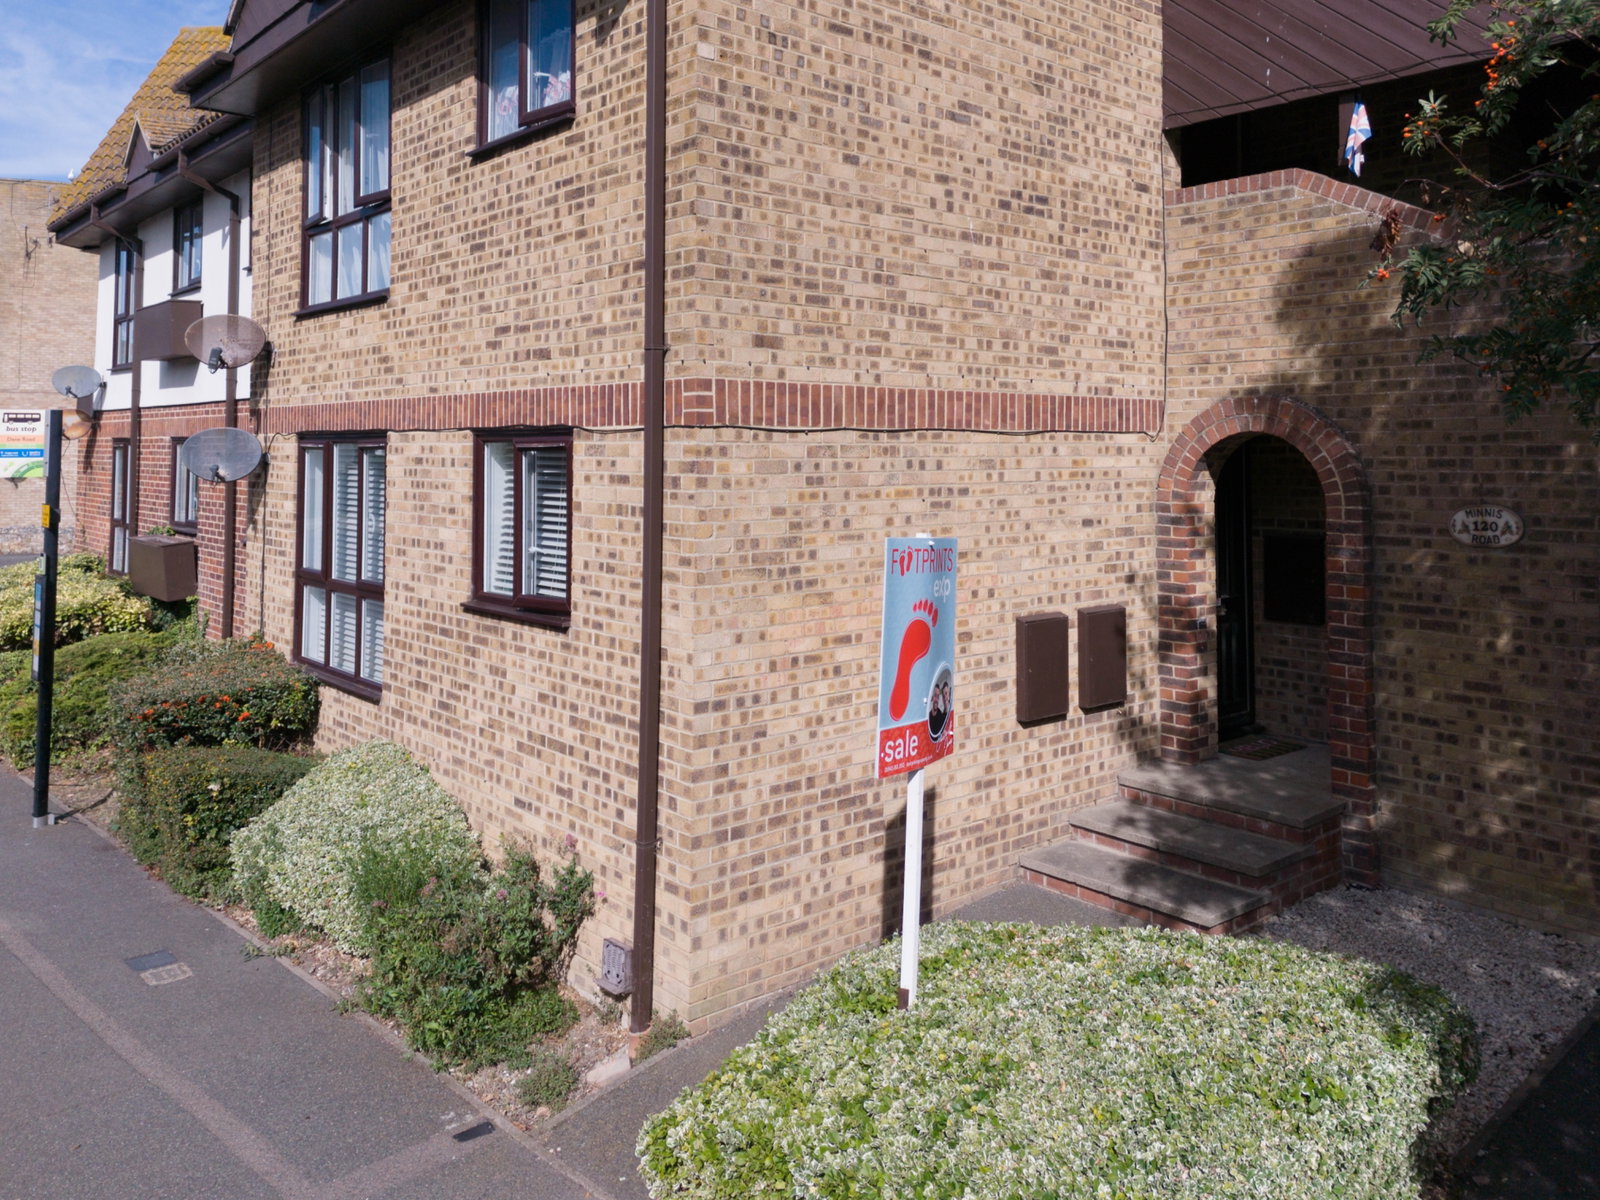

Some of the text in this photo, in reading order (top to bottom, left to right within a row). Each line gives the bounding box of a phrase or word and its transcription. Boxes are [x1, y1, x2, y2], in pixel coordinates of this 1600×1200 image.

[1465, 508, 1503, 519] MINNIS
[1471, 521, 1498, 533] 120
[1471, 534, 1500, 545] ROAD
[884, 729, 919, 763] sale
